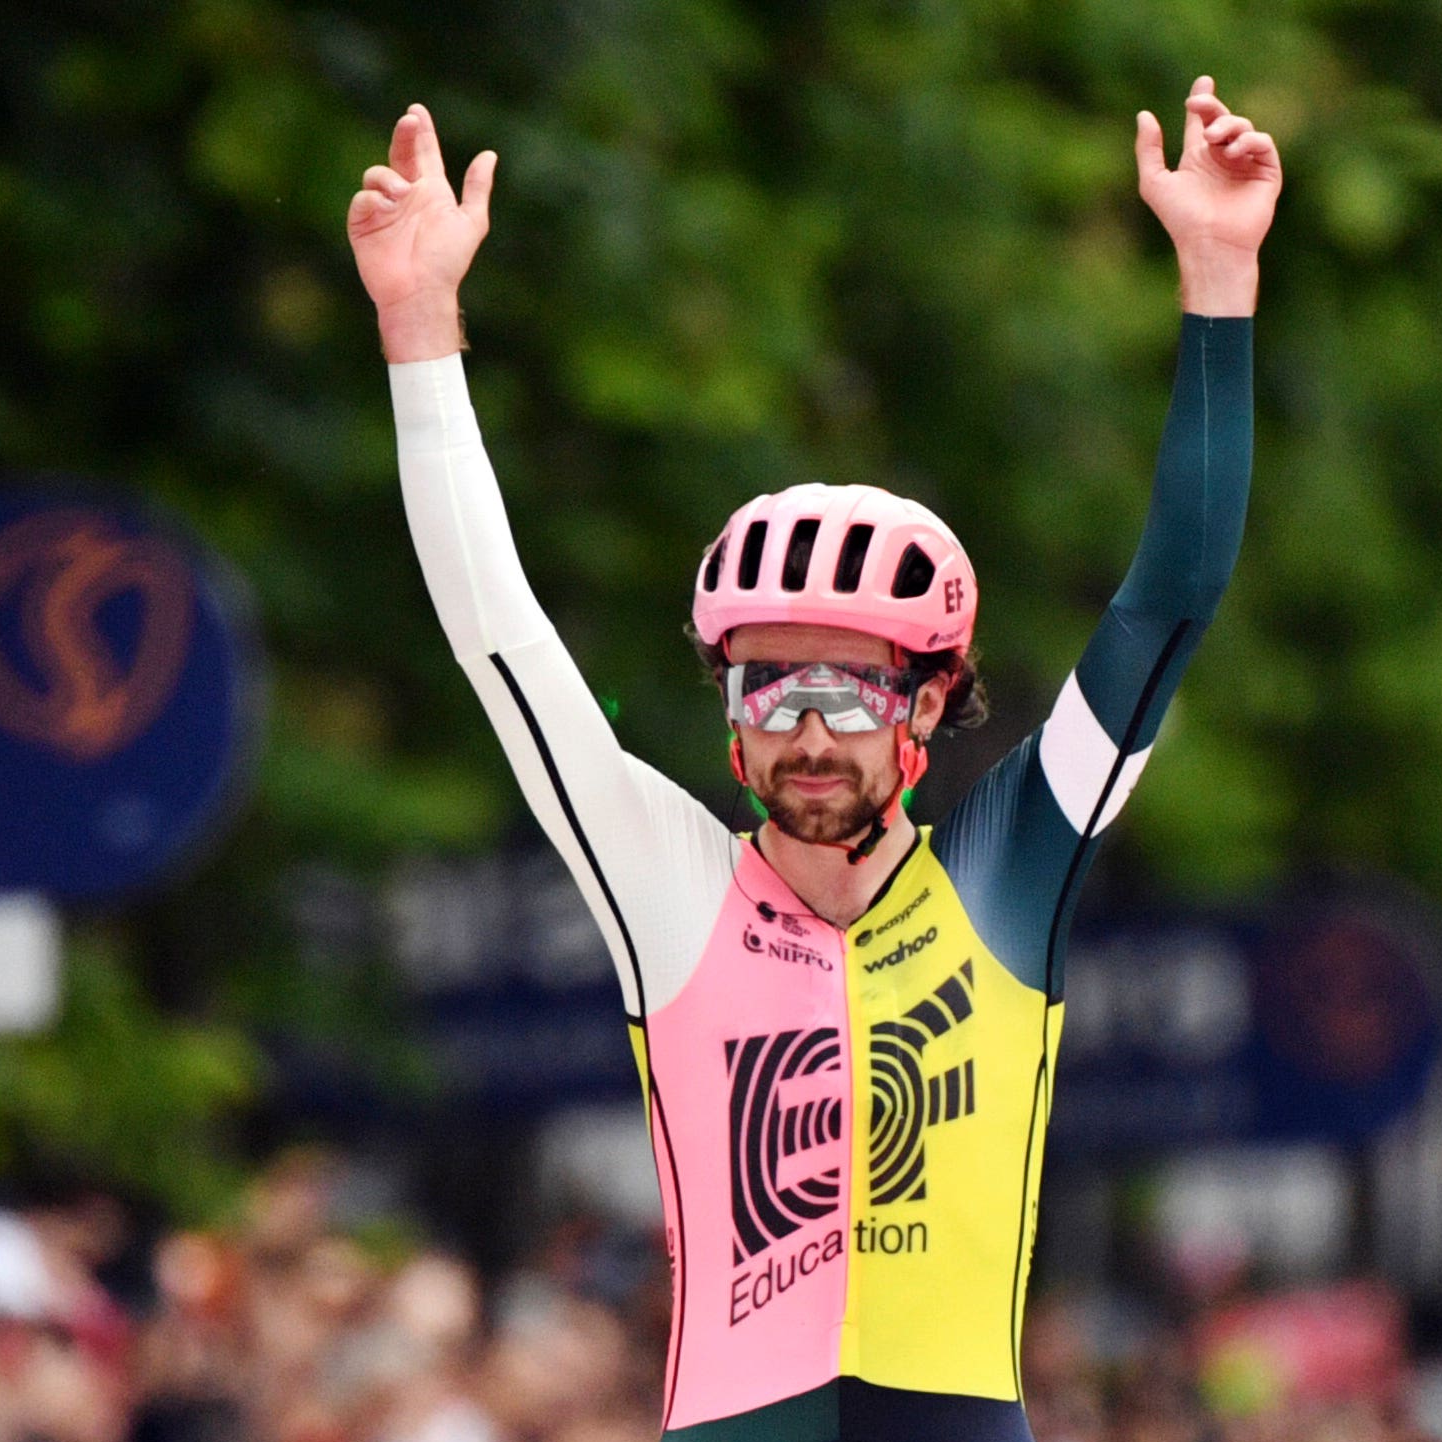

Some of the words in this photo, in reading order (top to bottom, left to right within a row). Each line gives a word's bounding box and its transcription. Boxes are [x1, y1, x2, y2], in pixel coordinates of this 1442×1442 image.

[943, 577, 964, 615] EF
[875, 887, 931, 935] easypost
[768, 942, 834, 972] NIPPO
[863, 926, 937, 975] wahoo
[729, 1218, 928, 1327] Education
